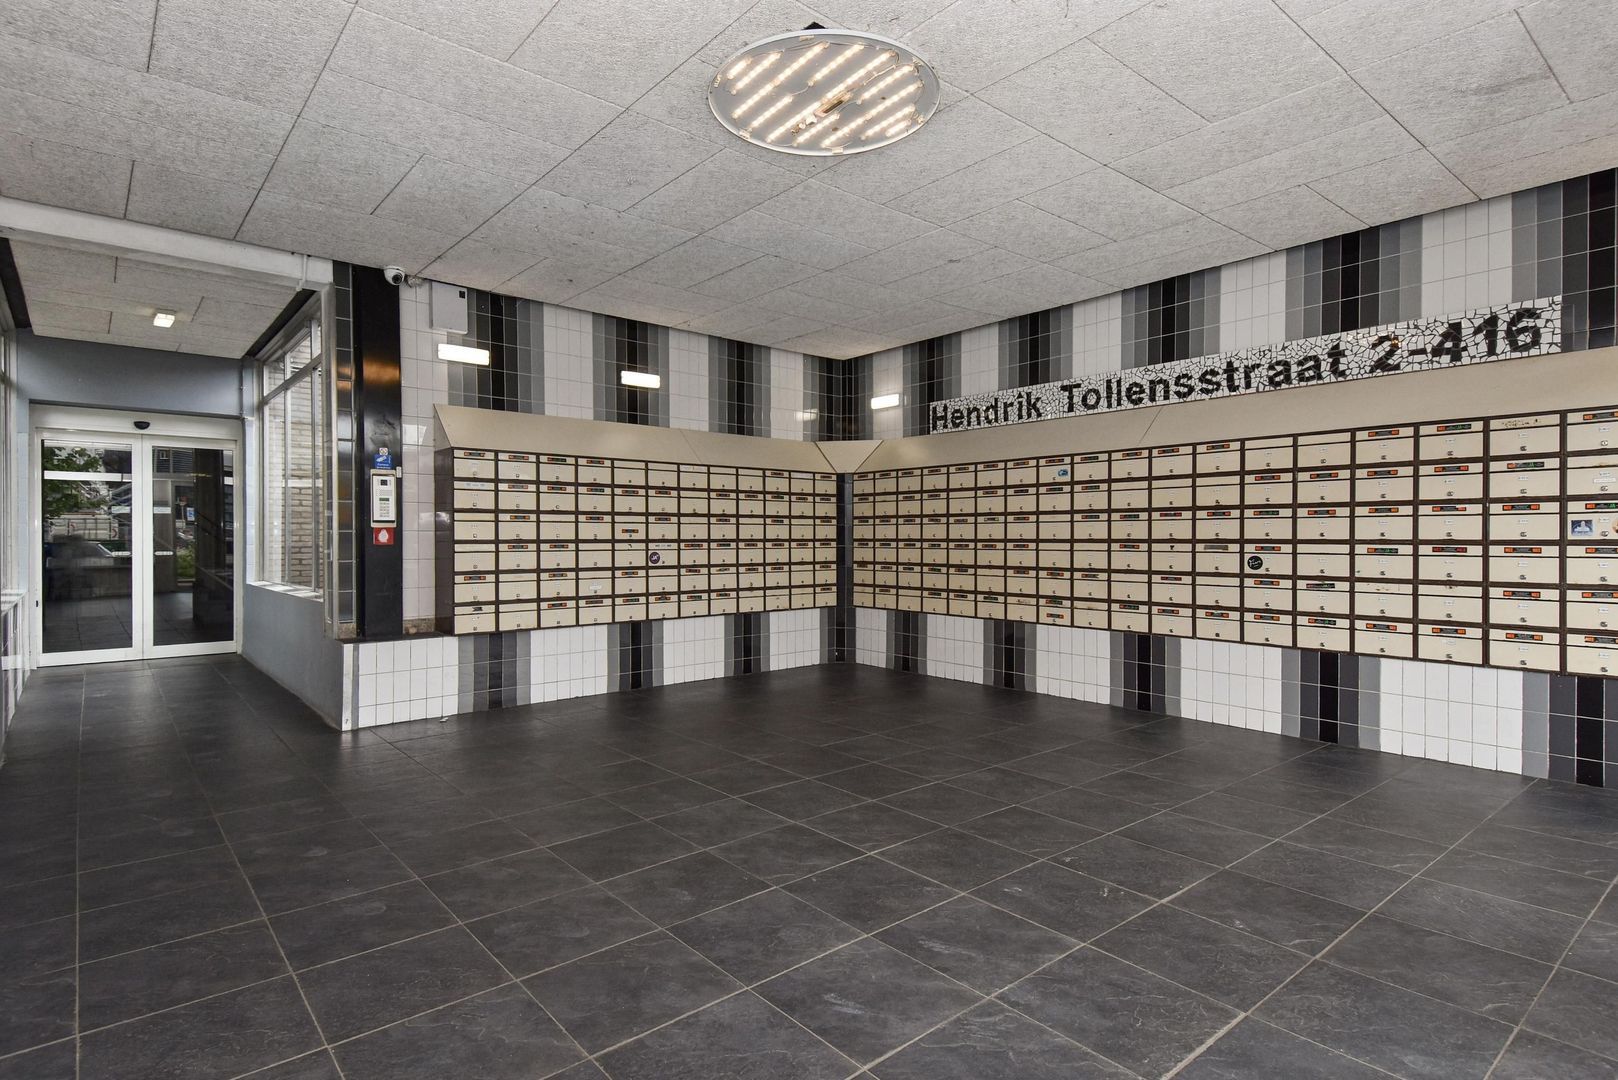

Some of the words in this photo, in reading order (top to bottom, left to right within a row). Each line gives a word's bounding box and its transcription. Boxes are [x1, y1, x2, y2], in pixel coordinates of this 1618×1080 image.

[932, 391, 1042, 432] Hendrik
[1060, 336, 1346, 414] Tollensstraat
[1369, 308, 1542, 373] 2-416
